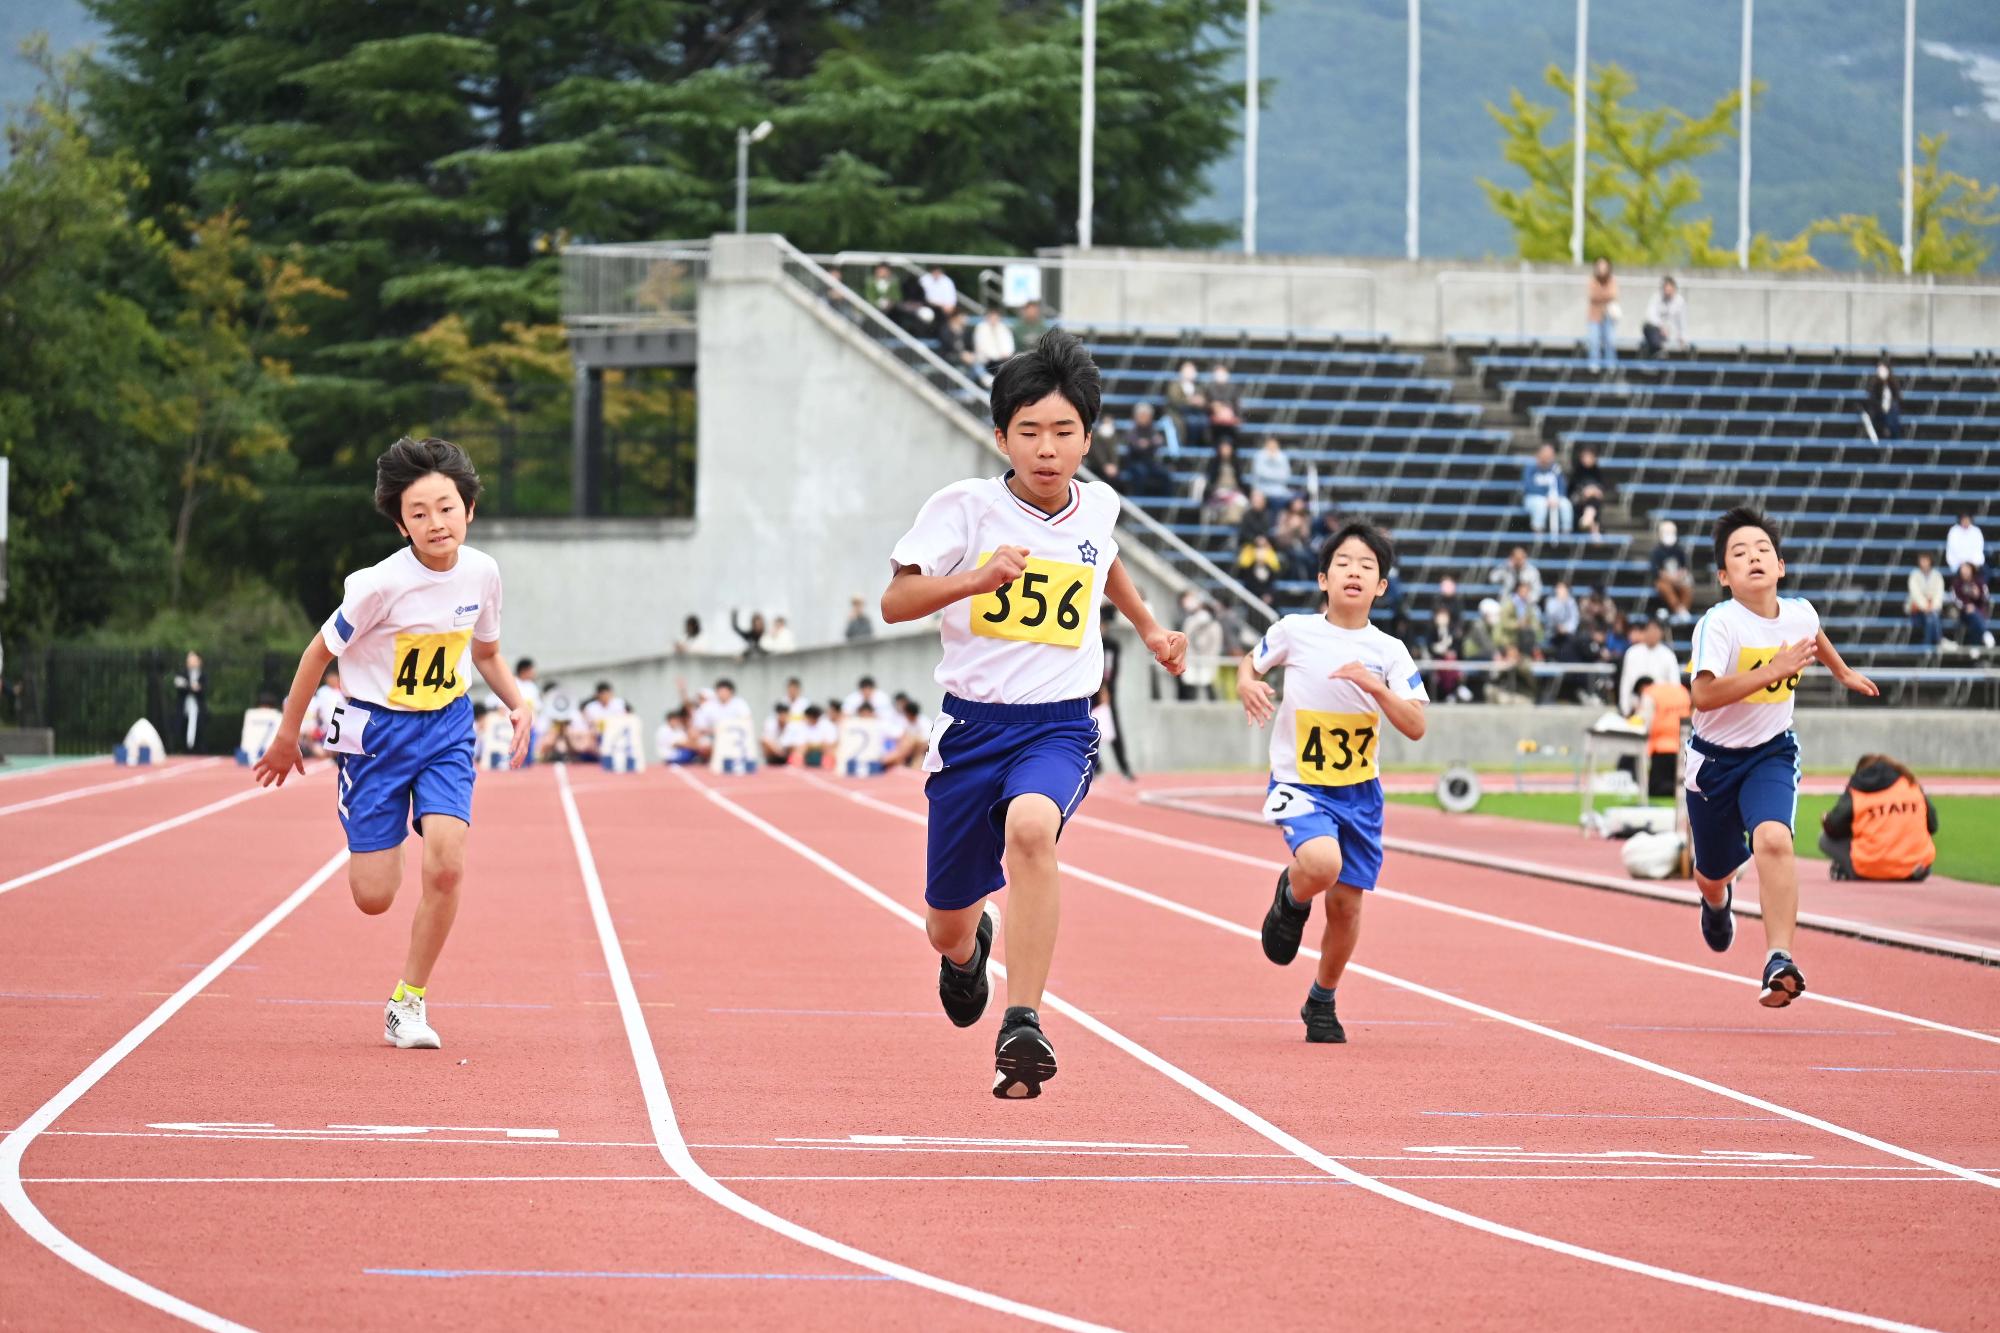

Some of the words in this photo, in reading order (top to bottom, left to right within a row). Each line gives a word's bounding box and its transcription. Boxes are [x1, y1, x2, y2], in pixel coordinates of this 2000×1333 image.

[982, 572, 1083, 630] 356
[327, 706, 345, 744] 5
[1302, 726, 1375, 771] 437
[1867, 802, 1917, 820] STAFF
